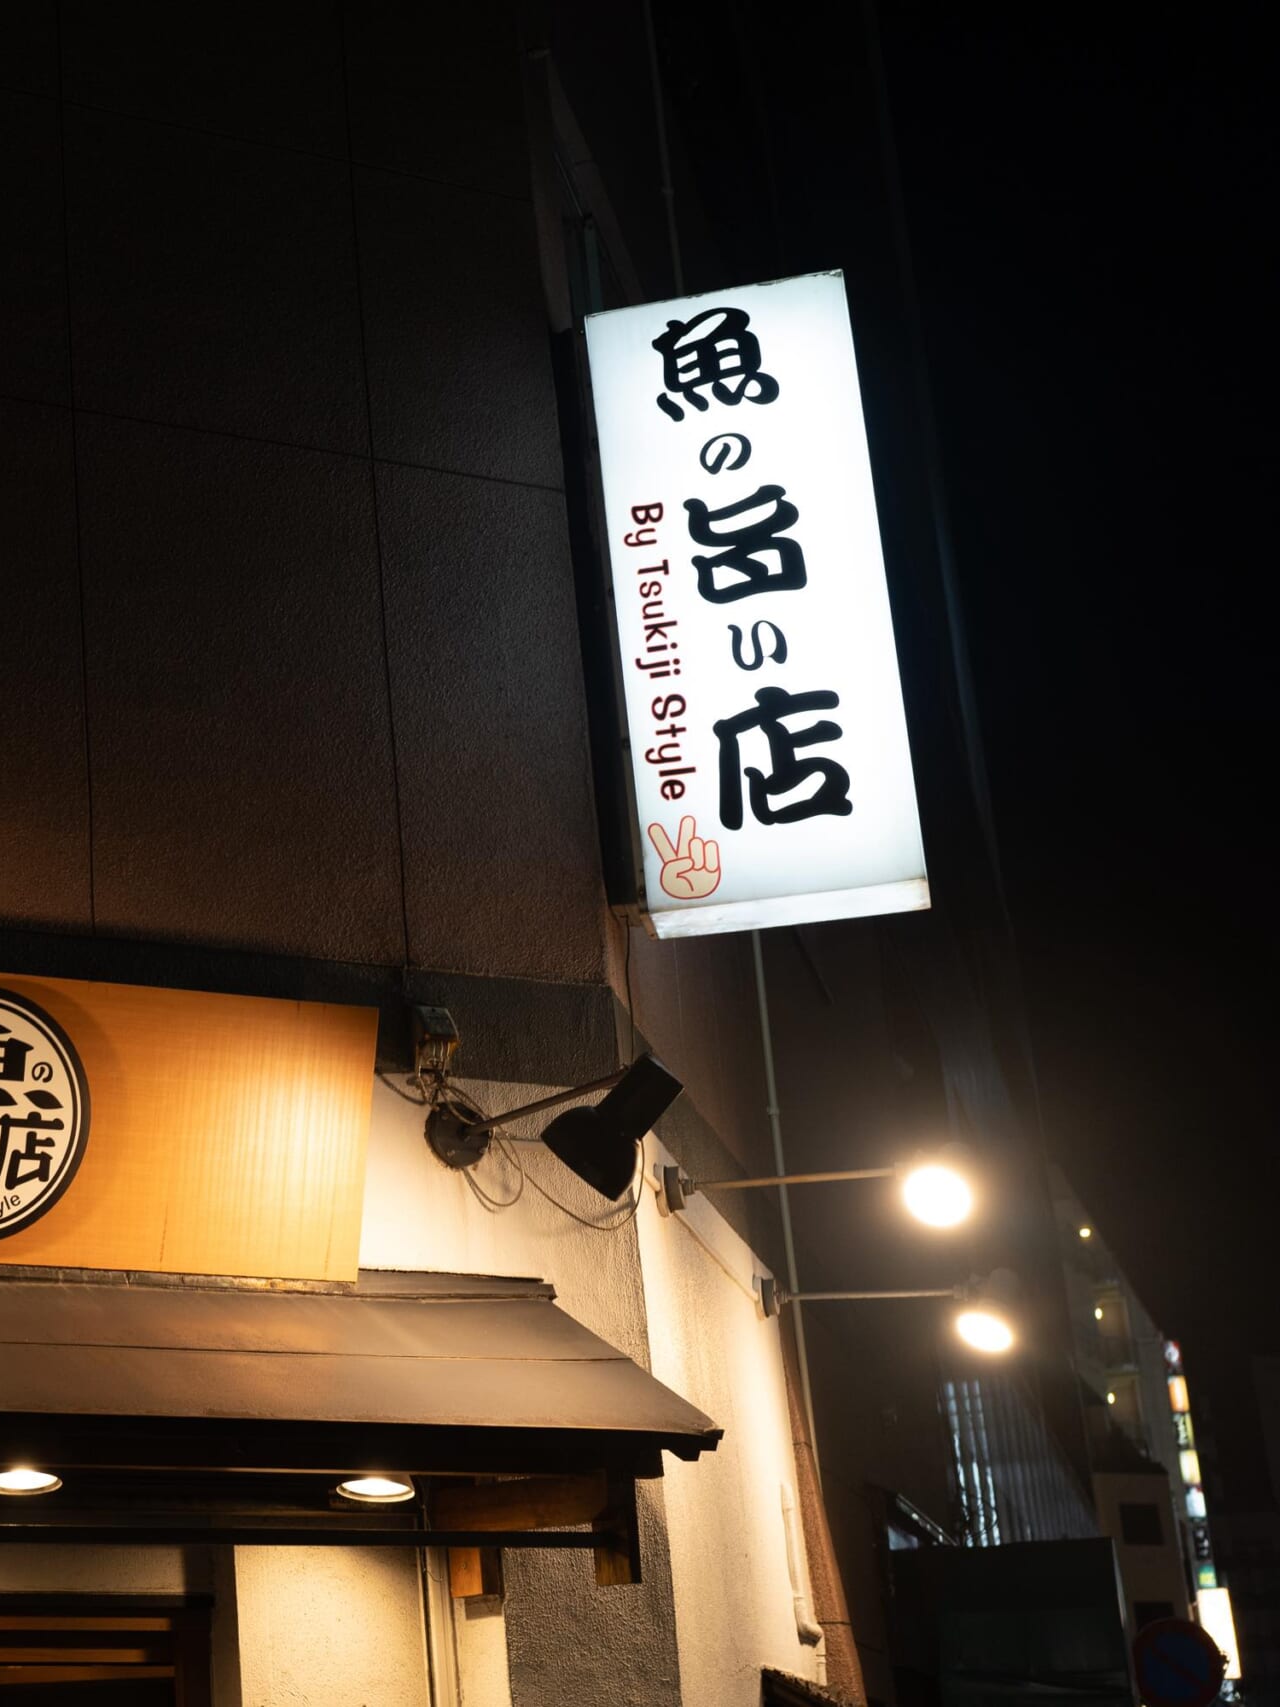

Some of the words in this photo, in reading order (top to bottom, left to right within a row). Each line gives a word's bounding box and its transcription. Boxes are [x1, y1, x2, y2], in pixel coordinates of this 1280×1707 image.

[623, 502, 664, 547] By
[652, 307, 853, 831] 魚の旨い店
[635, 559, 681, 679] Tsukiji
[644, 694, 696, 801] Style
